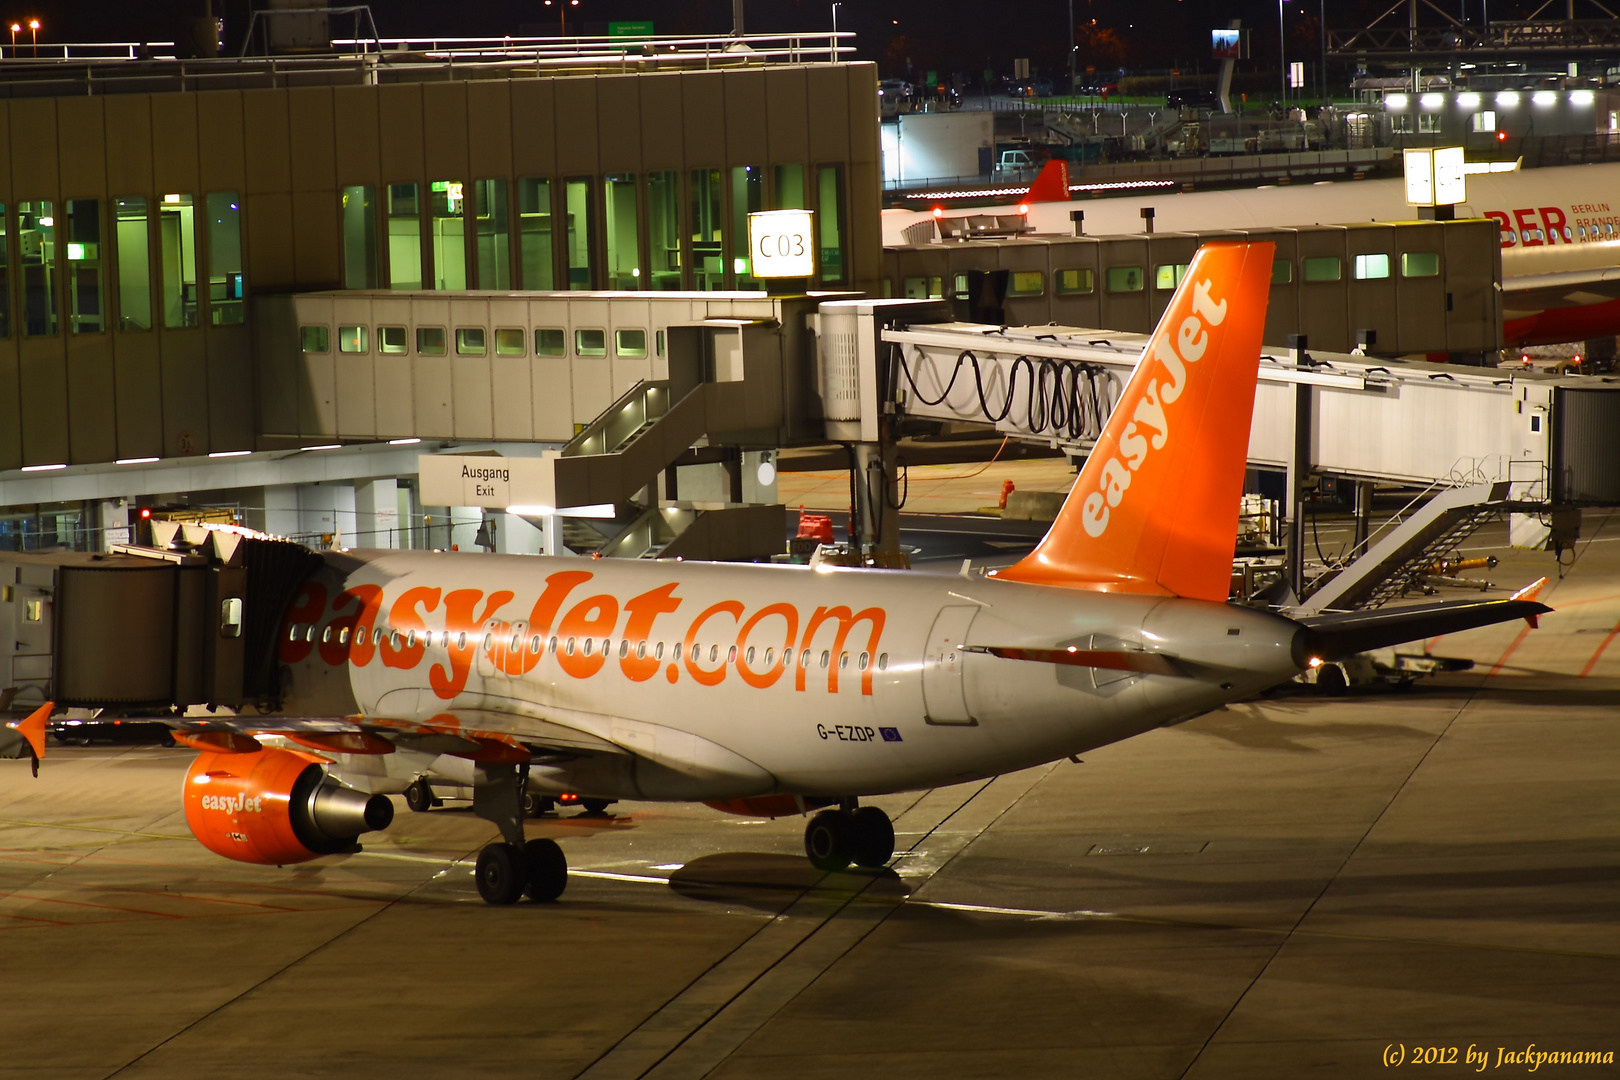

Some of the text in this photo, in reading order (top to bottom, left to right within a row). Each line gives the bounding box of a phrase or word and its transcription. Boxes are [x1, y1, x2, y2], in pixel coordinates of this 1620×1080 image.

[1571, 203, 1610, 214] BERLIN
[1484, 207, 1573, 248] BER
[1576, 216, 1620, 228] BRANDE
[1580, 231, 1620, 243] AIRPOR
[1082, 278, 1227, 537] easyJet
[462, 464, 509, 482] Ausgang
[476, 485, 494, 496] Exit
[279, 570, 886, 699] easyJet.com
[817, 724, 875, 742] G-EZDP
[202, 792, 262, 815] easyJet
